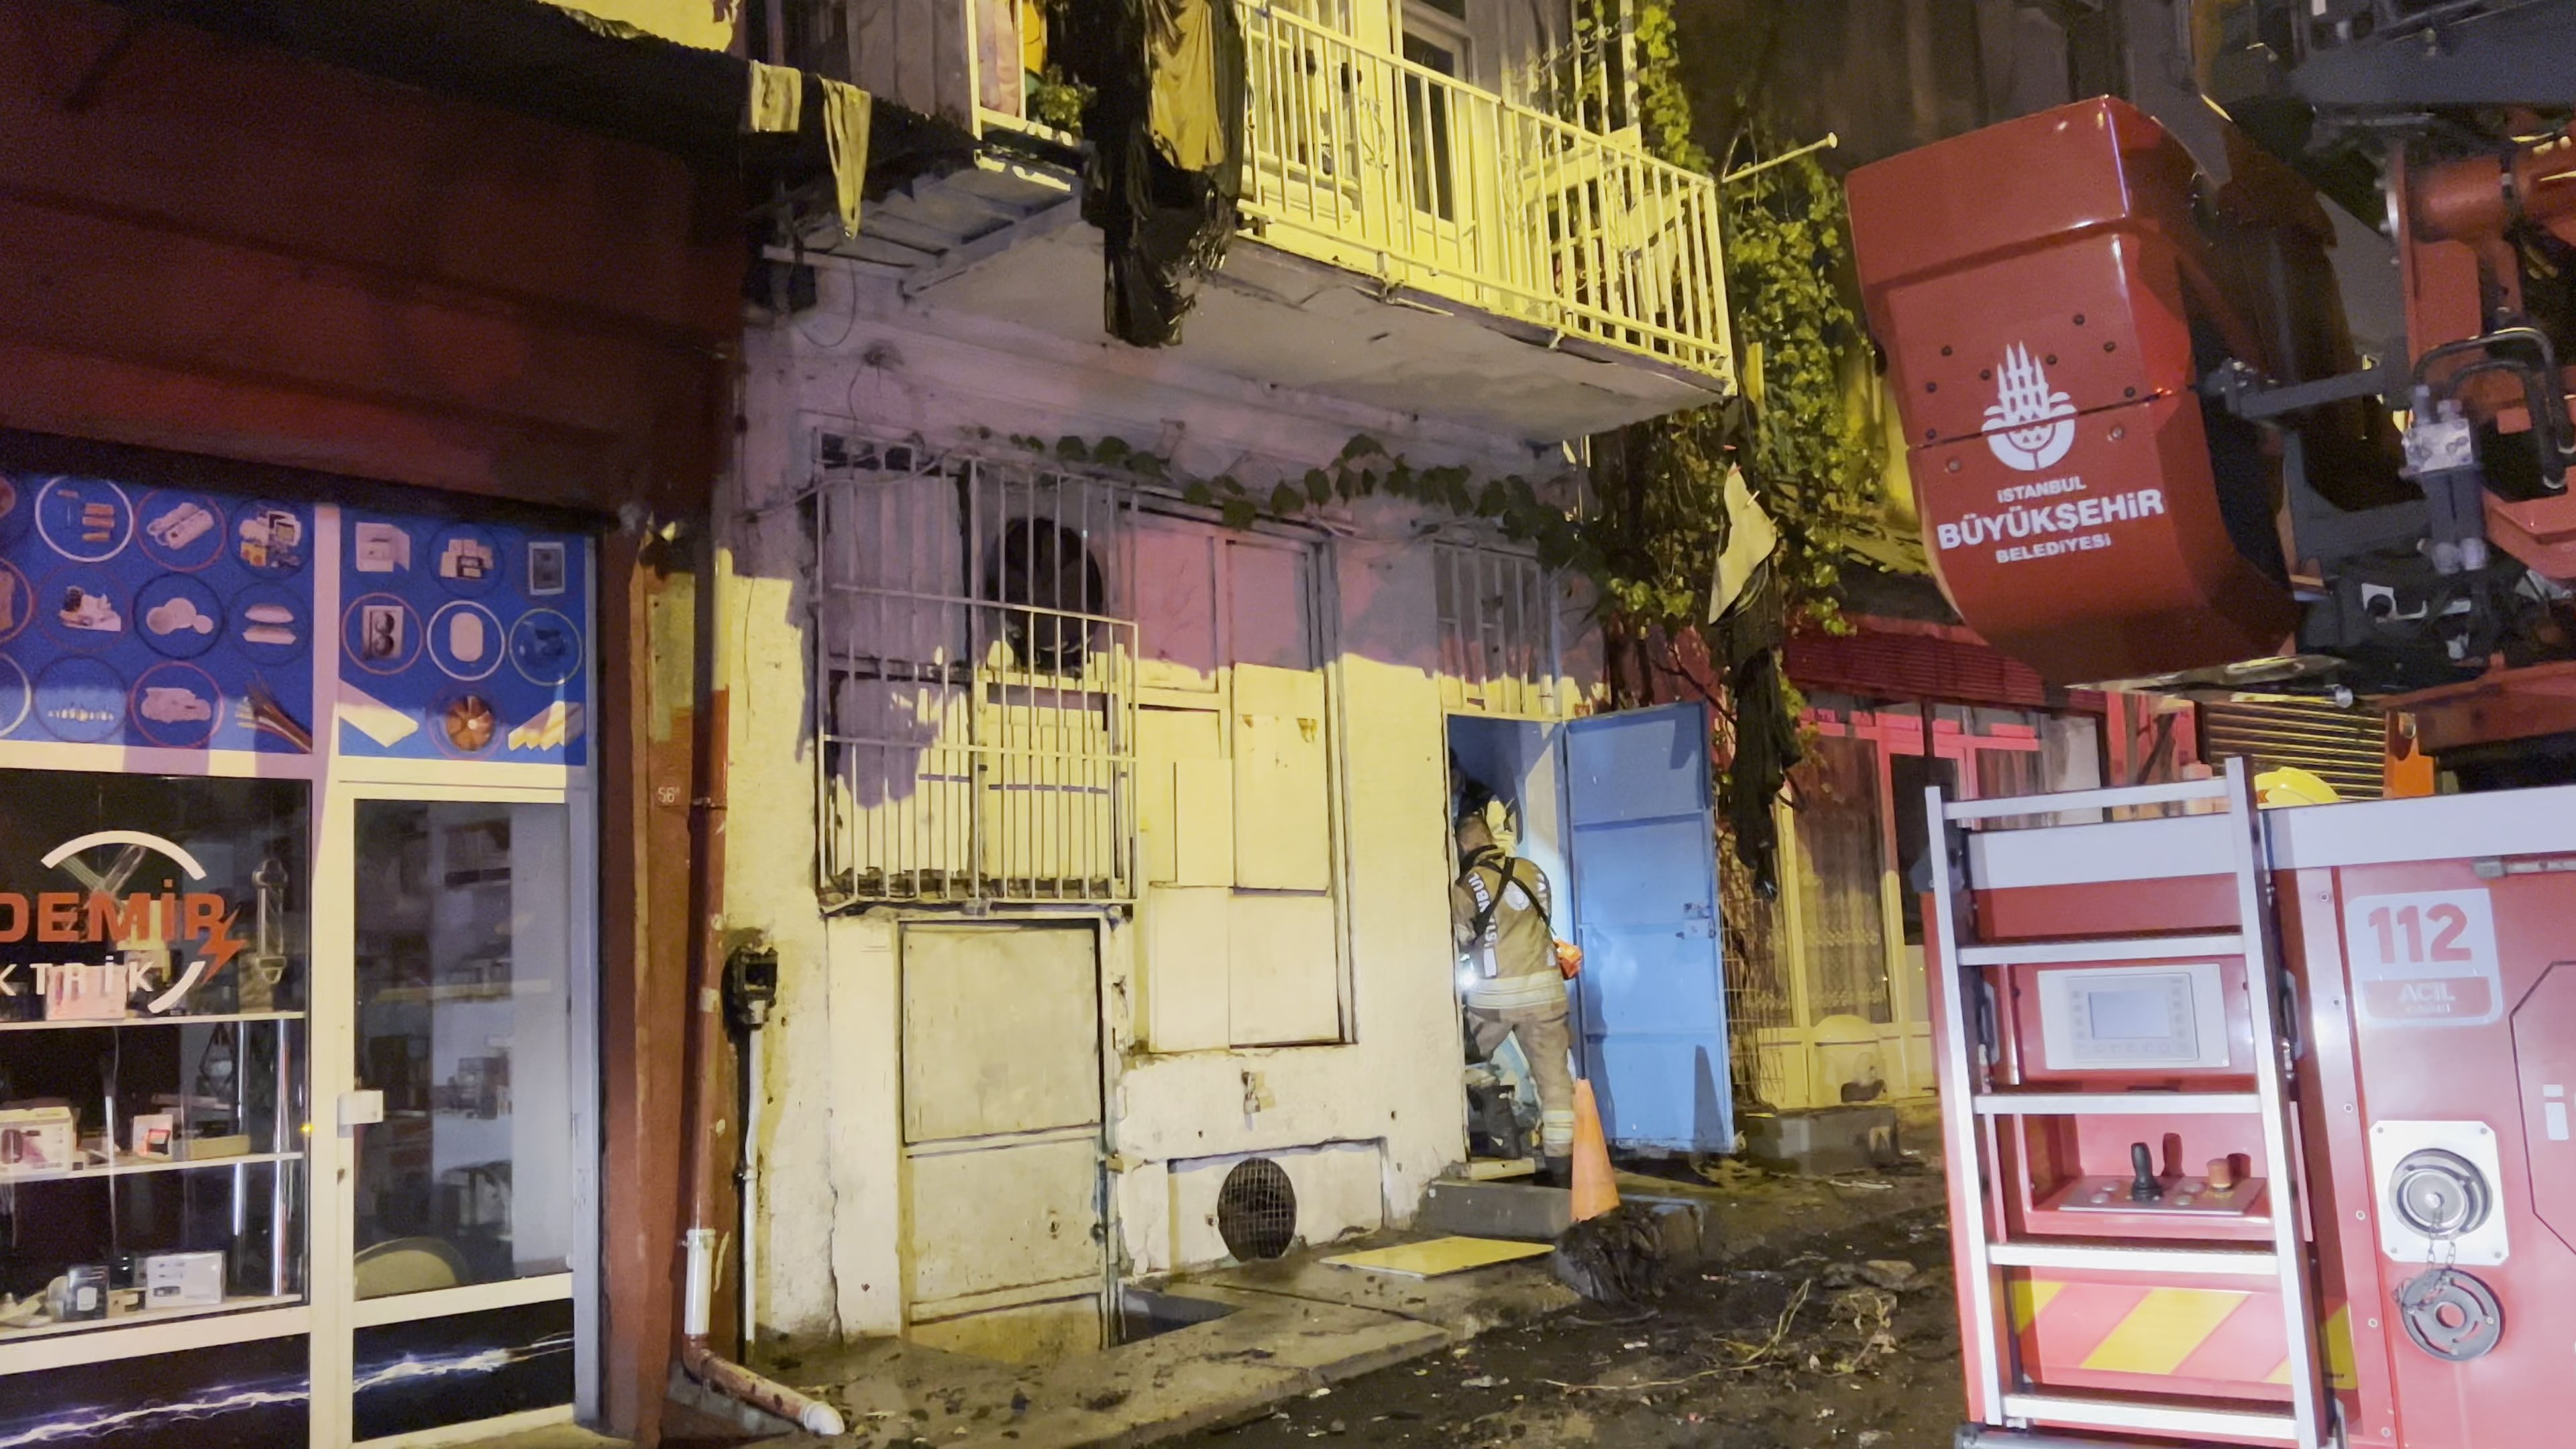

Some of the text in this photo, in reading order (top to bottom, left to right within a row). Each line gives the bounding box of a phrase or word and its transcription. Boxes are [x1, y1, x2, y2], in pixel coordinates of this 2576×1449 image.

[1996, 476, 2087, 503] İSTANBUL
[1937, 488, 2165, 550] BÜYÜKŞEHİR
[1996, 533, 2112, 564] BELEDİYESİ
[2368, 902, 2472, 963] 112
